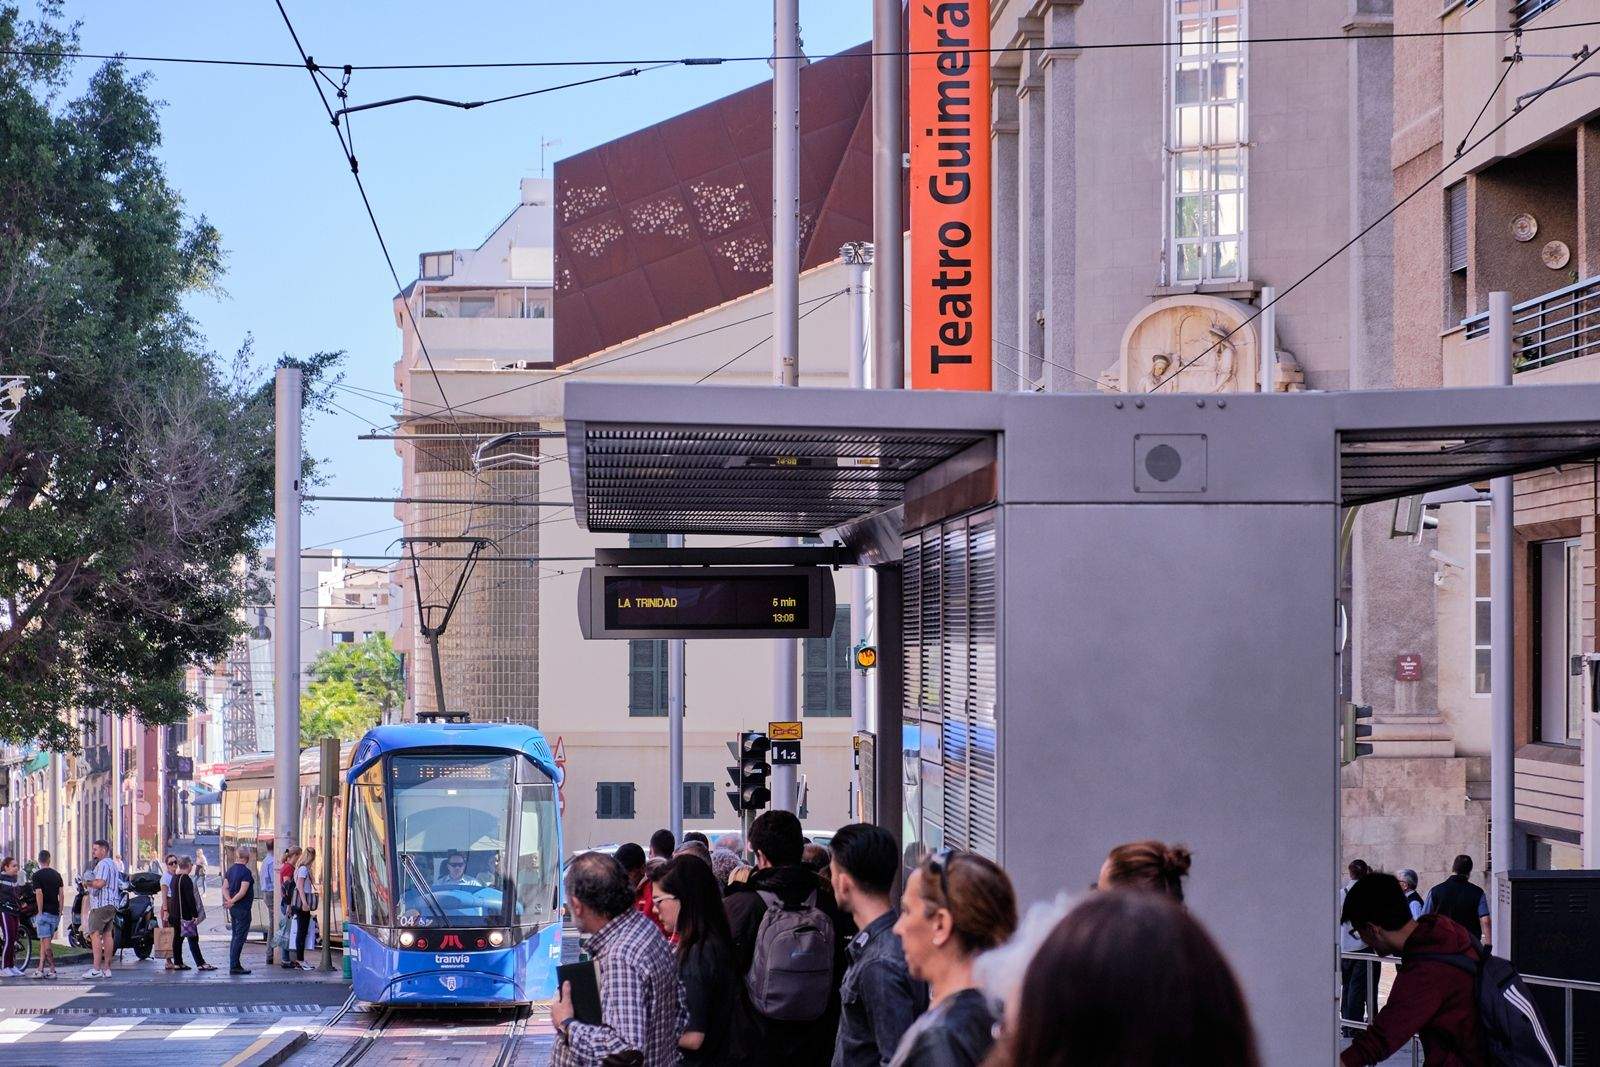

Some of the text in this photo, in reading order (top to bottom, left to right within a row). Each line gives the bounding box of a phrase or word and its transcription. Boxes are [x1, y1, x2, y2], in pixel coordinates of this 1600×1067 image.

[922, 2, 973, 374] Teatro Guimerá
[618, 598, 631, 608] LA
[635, 598, 678, 608] TRINIDAD
[780, 597, 796, 607] min
